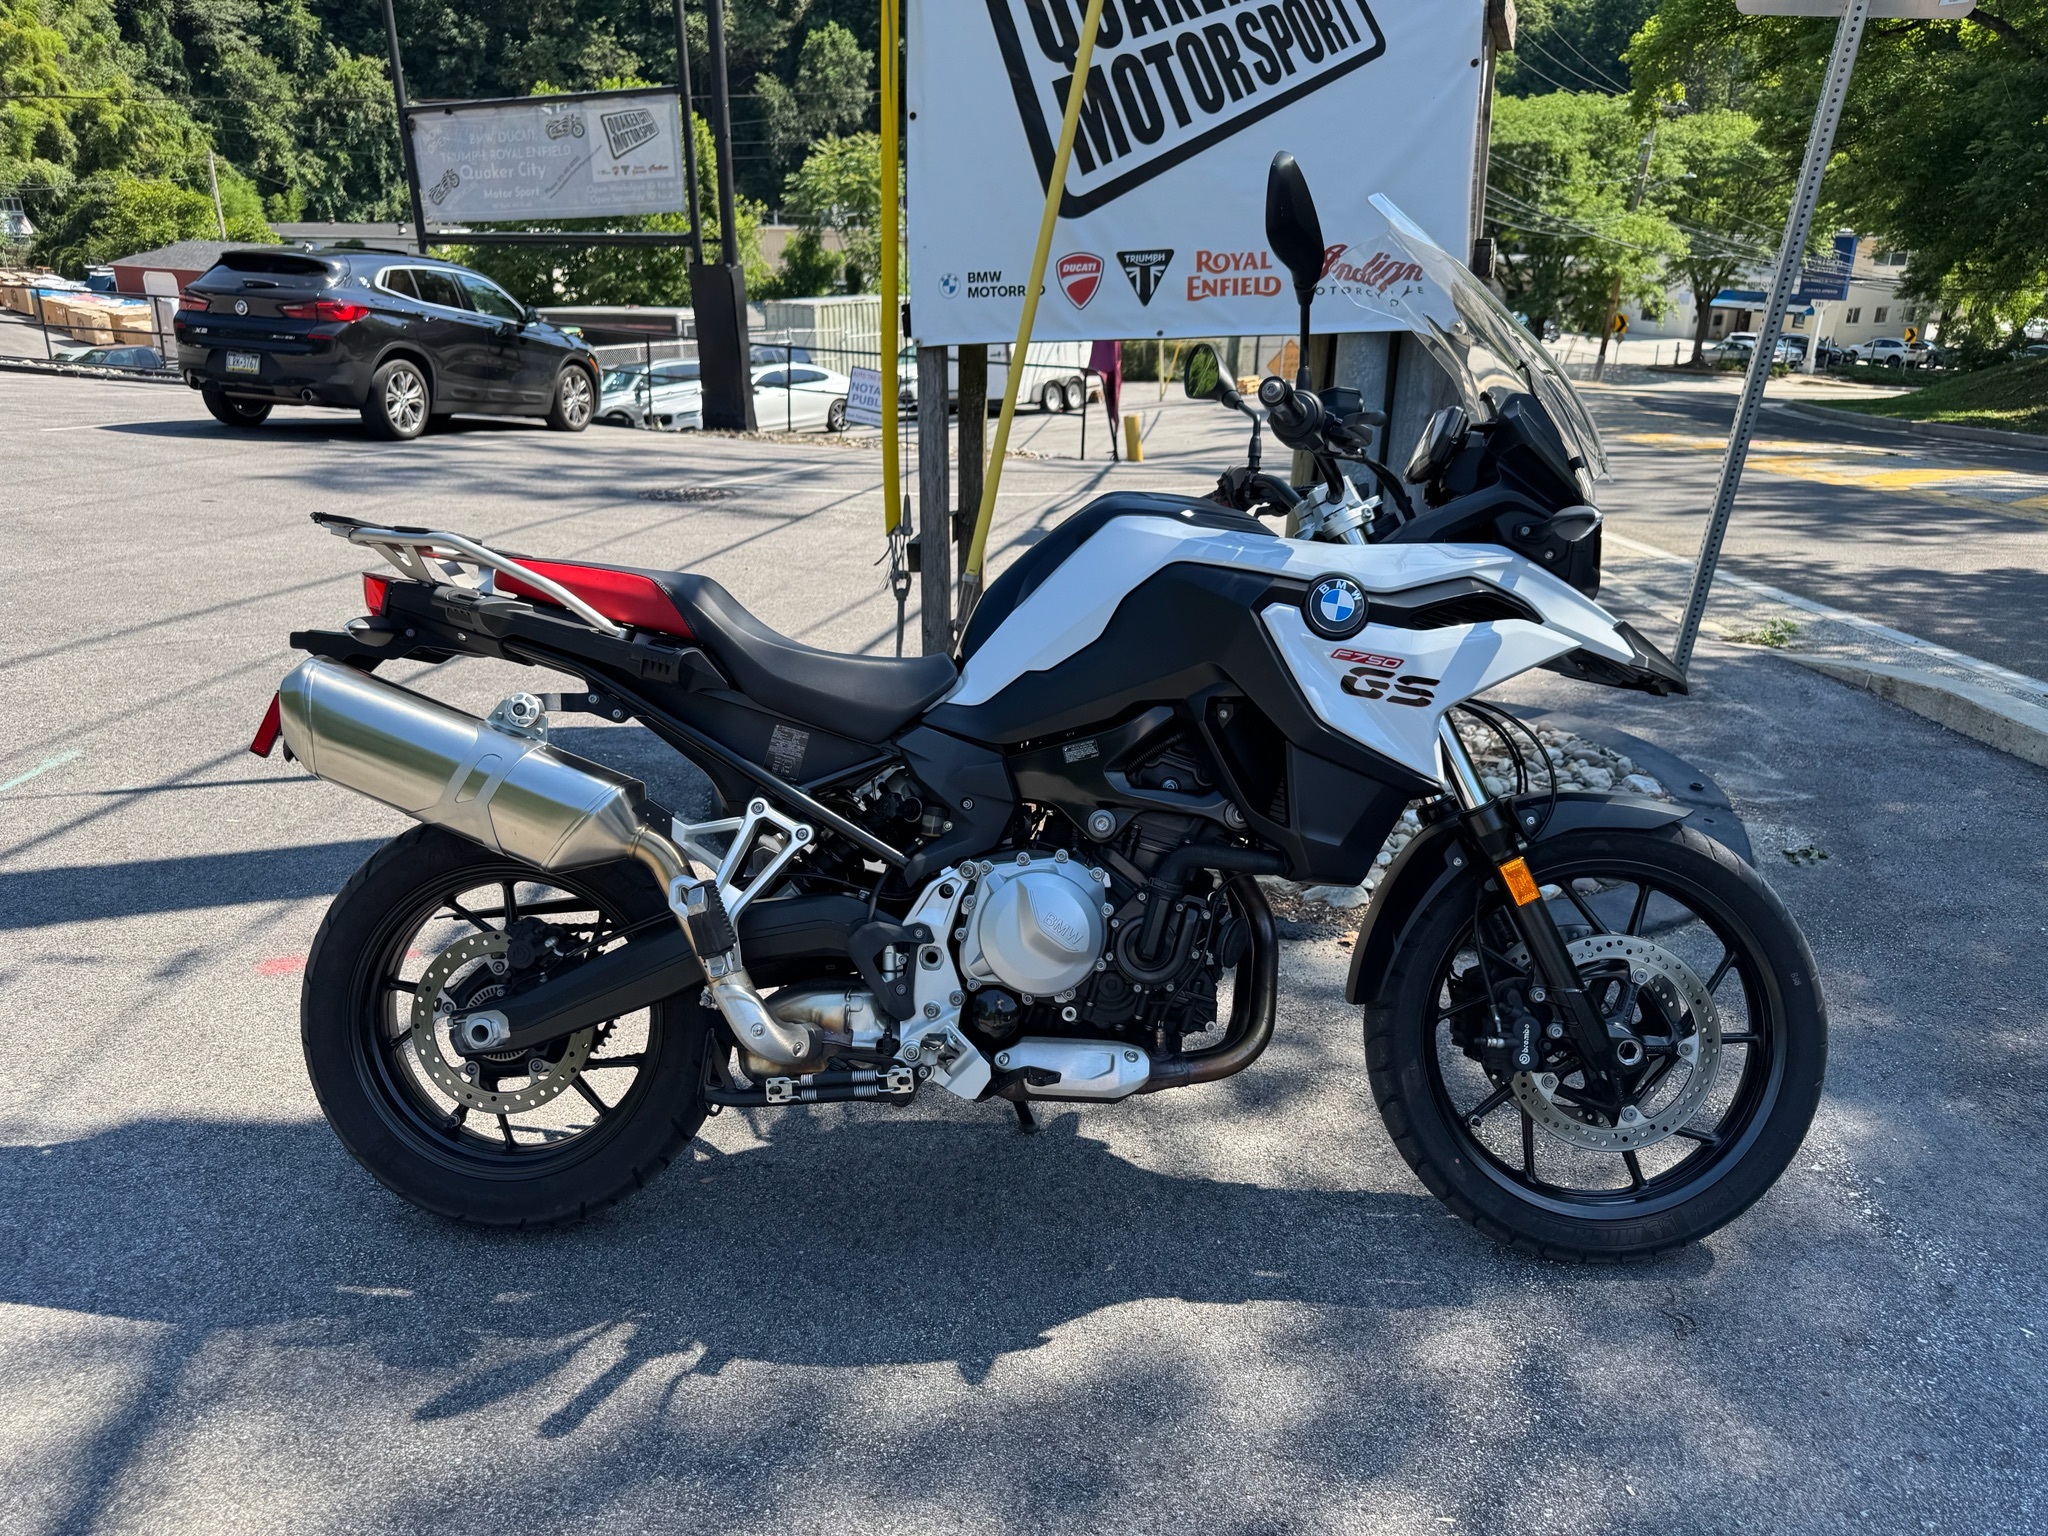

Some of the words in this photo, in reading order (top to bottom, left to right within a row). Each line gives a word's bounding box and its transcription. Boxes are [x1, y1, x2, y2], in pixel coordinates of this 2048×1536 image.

[460, 162, 515, 180] Quaker
[518, 161, 547, 180] City
[484, 188, 513, 199] Motor
[514, 186, 541, 199] Sport
[1062, 262, 1097, 273] DUCATI
[1124, 253, 1165, 264] TRIUMPH
[1196, 250, 1272, 274] ROYAL
[967, 271, 1002, 283] BMW
[1187, 276, 1282, 301] ENFIELD
[852, 382, 881, 396] NOTA
[852, 394, 881, 407] PUBL
[1319, 580, 1363, 601] BMW
[1340, 667, 1441, 707] GS
[1043, 912, 1084, 945] BMW
[1521, 1023, 1530, 1054] brembo
